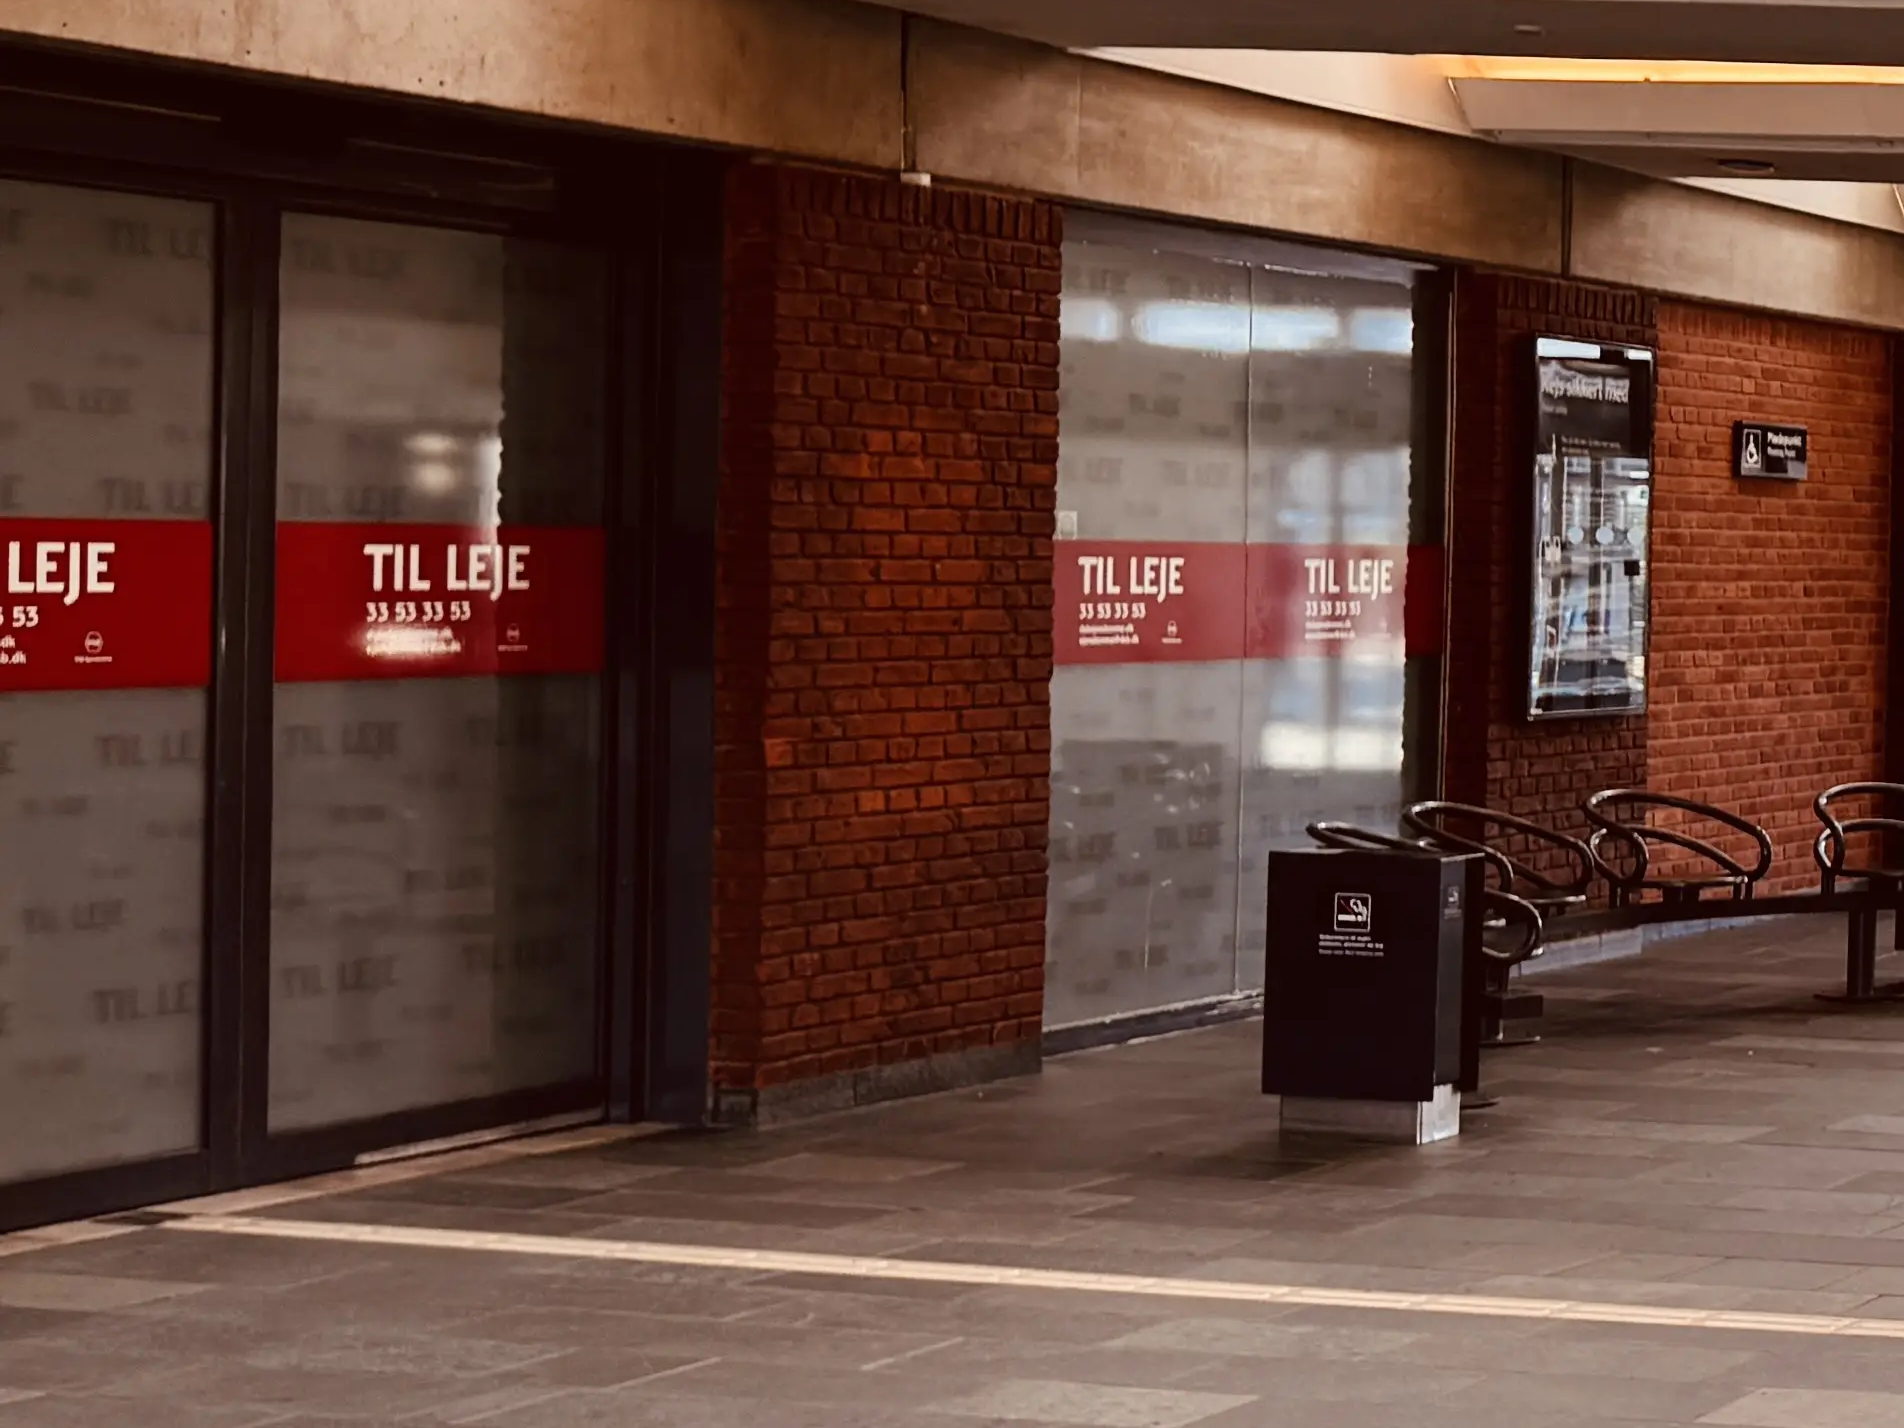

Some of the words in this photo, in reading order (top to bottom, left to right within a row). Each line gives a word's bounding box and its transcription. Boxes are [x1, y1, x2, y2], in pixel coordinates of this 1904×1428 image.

[8, 541, 116, 606] LEJE
[363, 543, 431, 592] TIL
[446, 543, 531, 602] LEJE
[1077, 555, 1121, 595] TIL
[1129, 555, 1185, 604] LEJE
[1304, 558, 1340, 594] TIL
[1347, 558, 1394, 601] LEJE
[12, 605, 39, 628] 53
[366, 601, 389, 623] 33
[394, 600, 417, 623] 53
[422, 601, 444, 623] 33
[450, 600, 471, 622] 53
